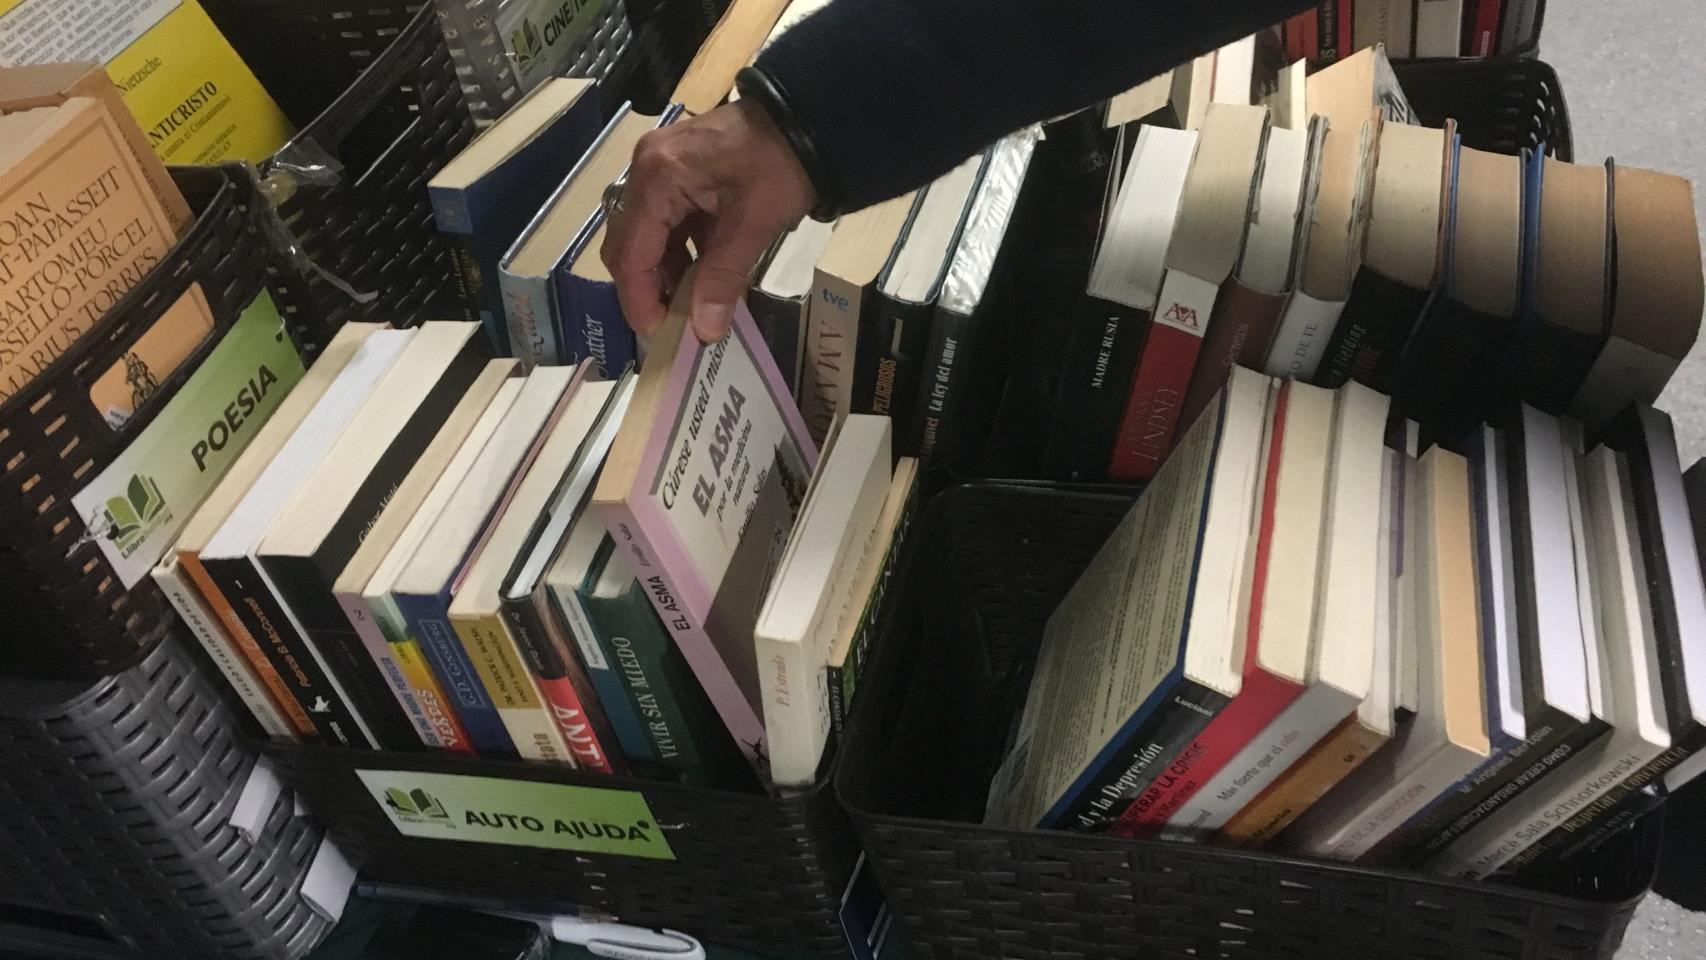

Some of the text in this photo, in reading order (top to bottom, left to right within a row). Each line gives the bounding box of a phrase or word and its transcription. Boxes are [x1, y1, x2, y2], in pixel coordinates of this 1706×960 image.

[148, 81, 218, 149] NTICRISTO
[0, 191, 51, 248] OAN
[0, 166, 121, 286] T-PAPASSEIT
[0, 217, 153, 370] SSELLO-PORCEL
[78, 246, 159, 323] TORRES
[821, 287, 850, 312] tve
[942, 337, 958, 365] amor
[1091, 315, 1120, 390] MADRE RUSIA
[1295, 338, 1310, 357] DE
[1303, 322, 1317, 337] FE
[1335, 323, 1366, 365] Fielding
[872, 357, 897, 414] PELIGROSOS
[931, 380, 951, 398] ley
[936, 364, 951, 382] del
[190, 364, 278, 473] POESIA
[929, 395, 943, 413] La
[1133, 389, 1177, 460] LINDSEY
[662, 439, 692, 510] Cúrese
[689, 379, 711, 441] usted
[692, 384, 746, 518] EL ASMA
[716, 419, 752, 522] por la medicina
[733, 455, 750, 506] natural
[647, 575, 682, 615] ASMA
[428, 620, 460, 677] GINSBURG
[671, 615, 691, 632] EL
[417, 690, 460, 749] VERDES
[611, 636, 678, 760] VIVIR SIN MIEDO
[1102, 741, 1163, 798] Depresión
[1161, 772, 1176, 790] LA
[1171, 740, 1204, 777] CRISIS
[1234, 764, 1259, 790] fuerte
[1256, 752, 1276, 771] que
[1516, 760, 1545, 787] CREAR
[465, 809, 544, 832] AUTO
[554, 820, 651, 843] AJUDA
[1090, 806, 1102, 823] y
[1098, 791, 1113, 811] la
[1453, 781, 1516, 835] ORGANIZACIONES
[1517, 815, 1550, 842] Sala
[1545, 757, 1641, 818] Schnorkowski
